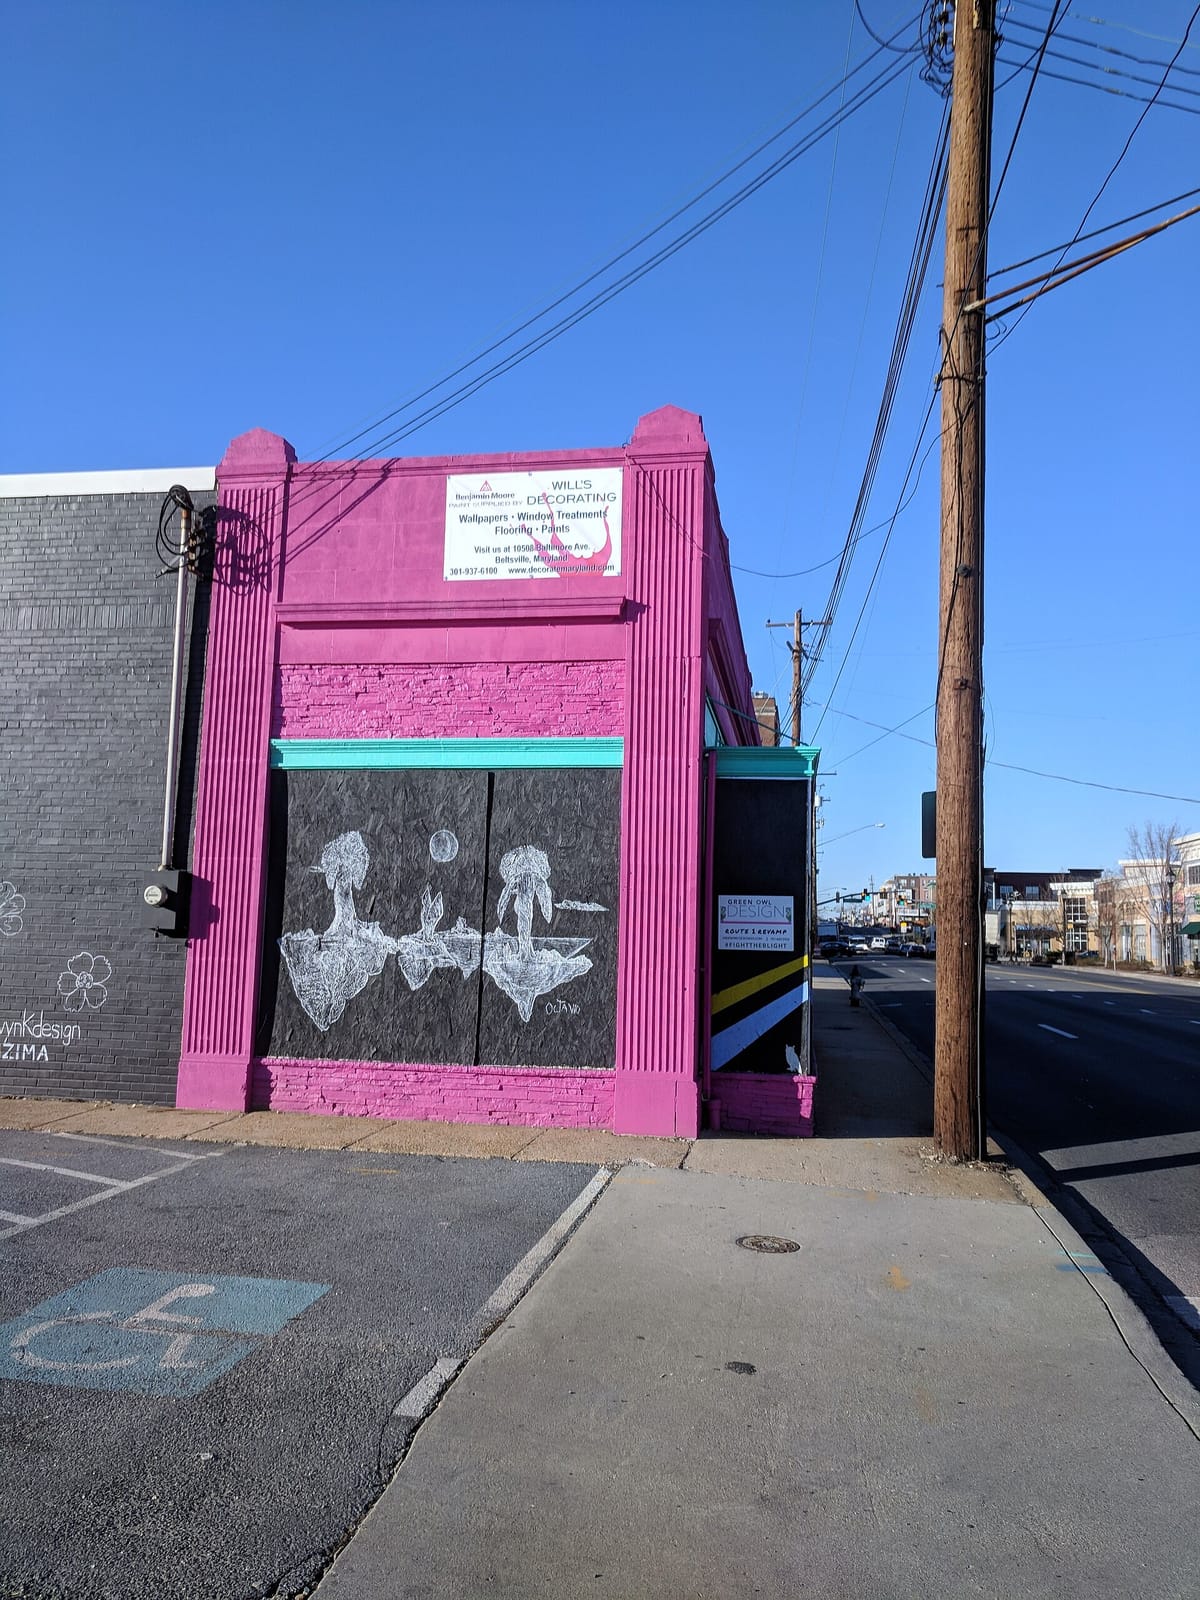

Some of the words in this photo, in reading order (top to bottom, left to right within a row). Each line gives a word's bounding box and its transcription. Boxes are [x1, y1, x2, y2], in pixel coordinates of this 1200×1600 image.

[552, 480, 592, 490] WILL'S
[455, 492, 490, 501] Benjamin
[527, 492, 617, 505] DECORATING
[459, 514, 509, 525] Wallpapers
[517, 511, 553, 521] Window
[556, 510, 607, 519] Treatments
[495, 525, 533, 536] Flooring
[541, 524, 570, 534] Paints
[474, 545, 490, 553] Visit
[513, 544, 534, 552] 10508
[495, 555, 532, 564] Beltsville,
[533, 554, 568, 564] Maryland
[449, 567, 498, 576] 301-937-6100
[508, 564, 615, 575] www.decoratemaryland.com
[727, 905, 785, 918] DESIGN
[2, 1043, 49, 1061] ZIMA
